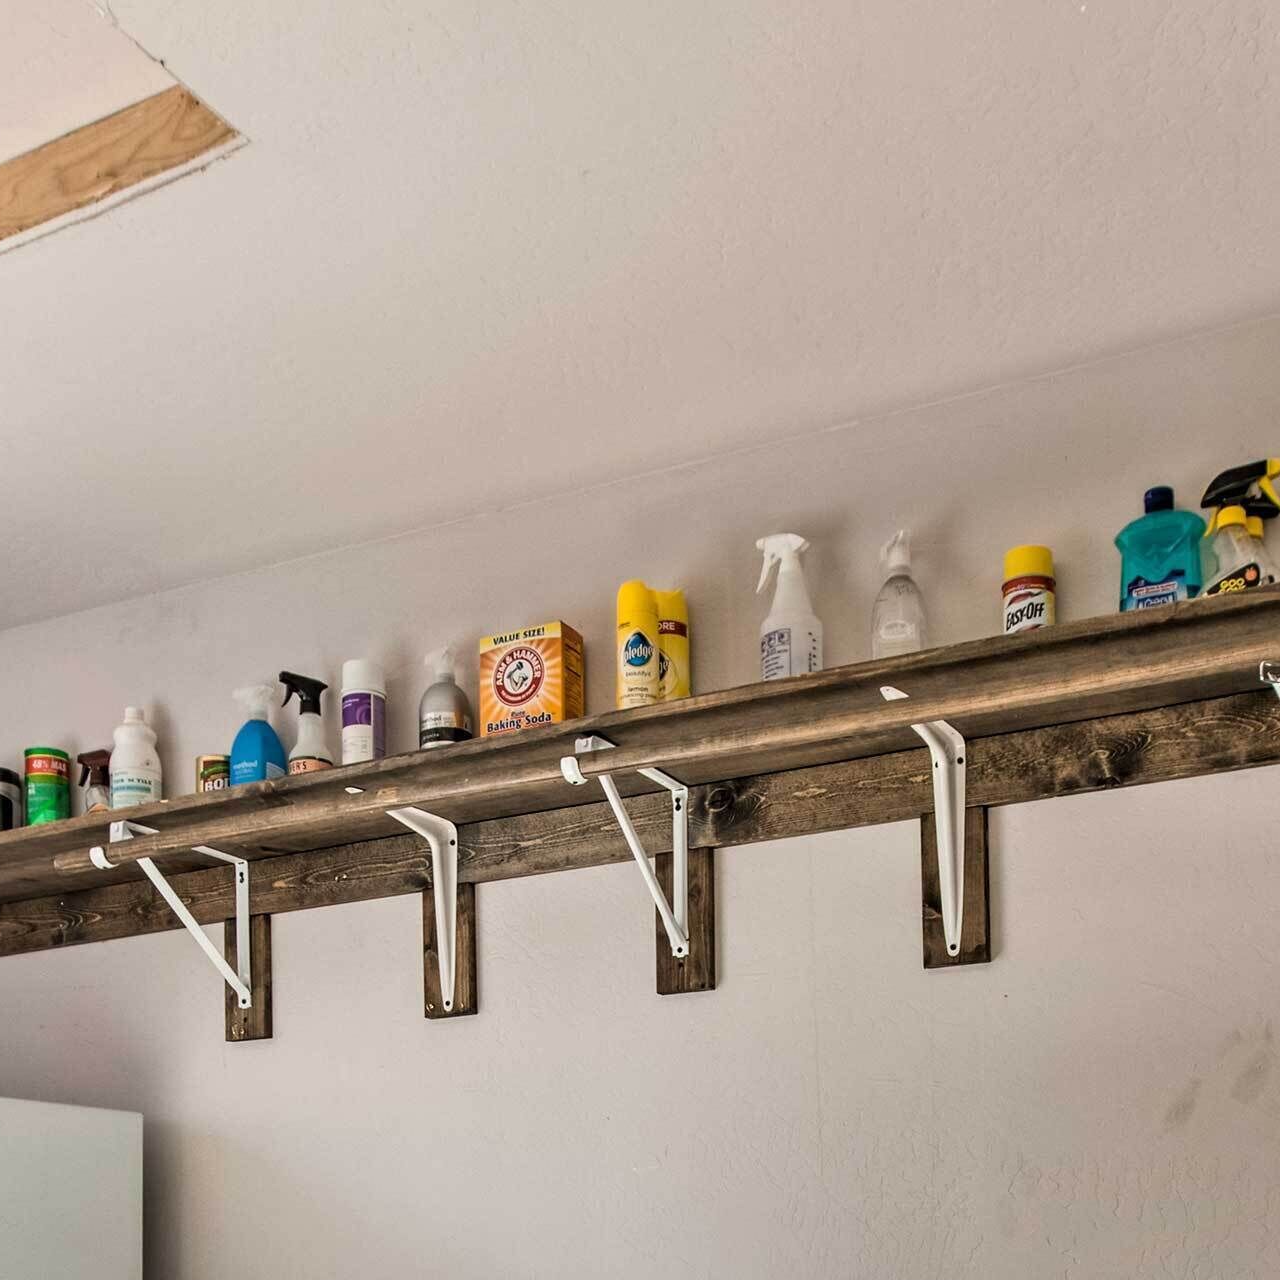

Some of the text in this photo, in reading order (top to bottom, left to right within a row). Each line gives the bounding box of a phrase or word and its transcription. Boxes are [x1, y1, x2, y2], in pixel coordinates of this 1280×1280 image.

[1006, 602, 1045, 630] EASY-OFF
[493, 628, 545, 645] VALUE SIZE!
[624, 645, 654, 664] pledge
[495, 664, 506, 686] ARM
[512, 650, 543, 678] HAMMER
[487, 712, 552, 733] Baking Soda
